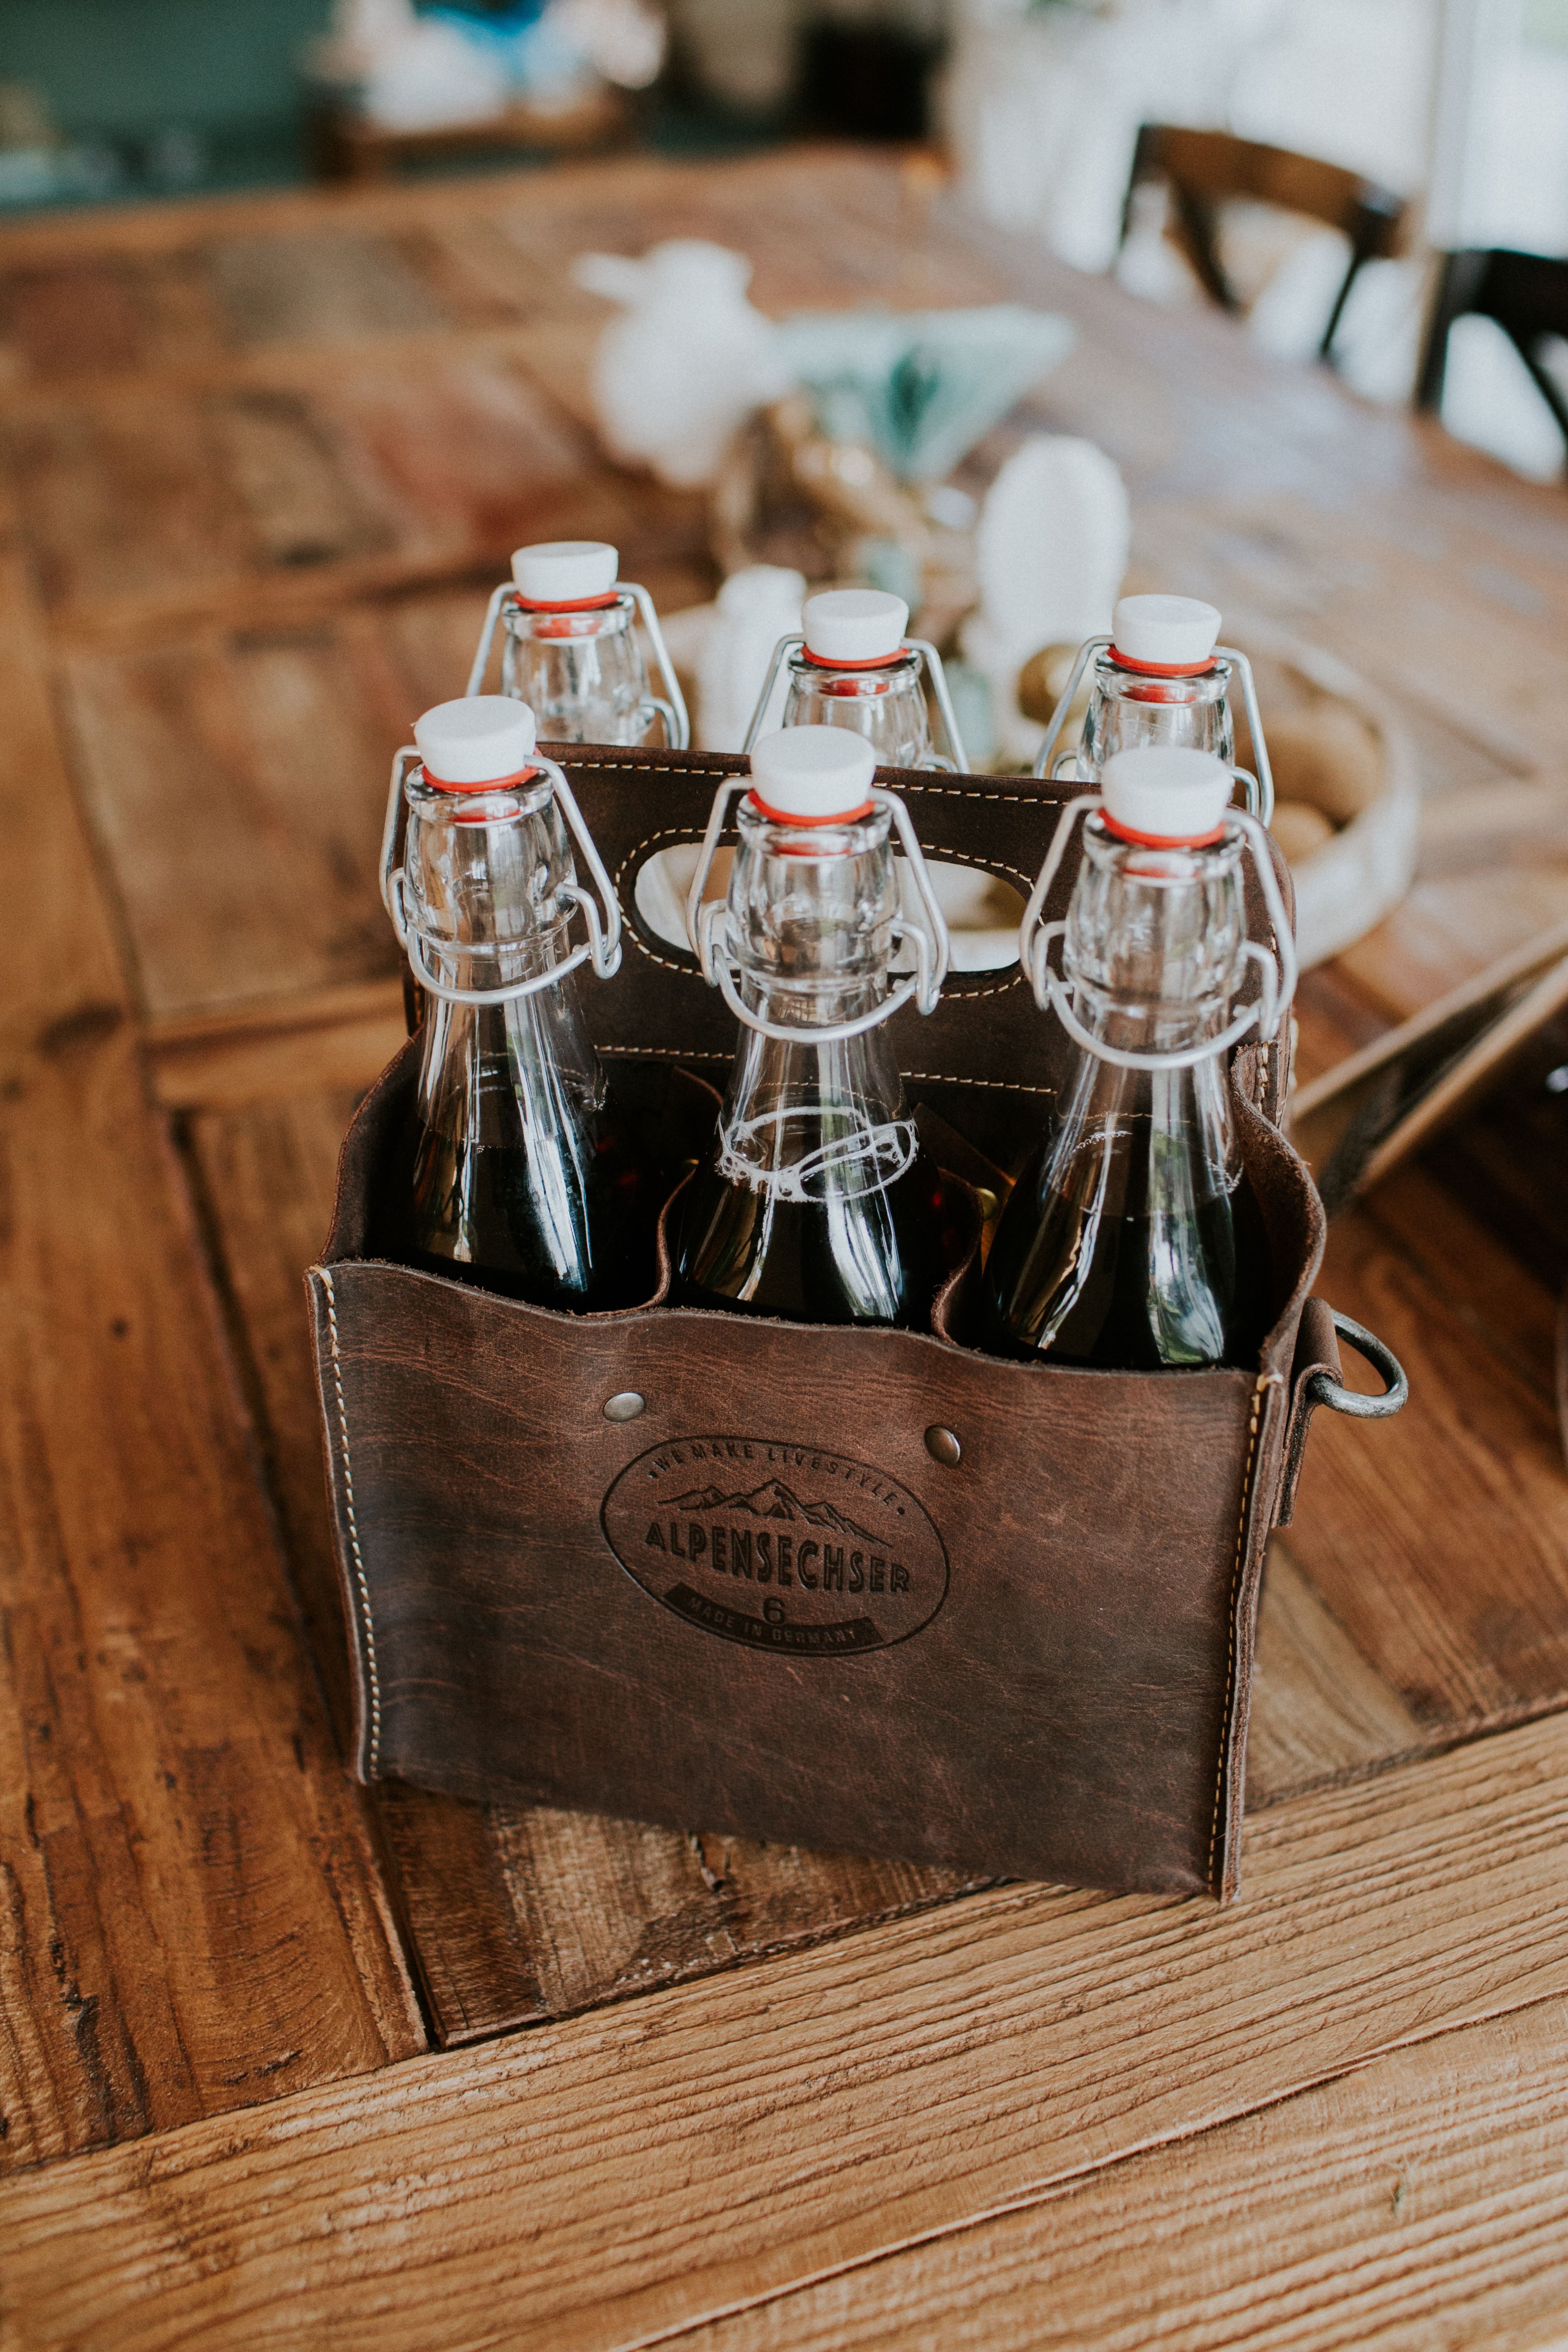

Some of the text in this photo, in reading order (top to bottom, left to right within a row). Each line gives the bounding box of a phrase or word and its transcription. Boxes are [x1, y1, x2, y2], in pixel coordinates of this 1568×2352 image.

[653, 1443, 897, 1506] WE MAKE LIVESTYLE
[646, 1521, 910, 1594] ALPENSECHSER
[687, 1596, 856, 1644] MADE IN GERMANY
[762, 1596, 786, 1625] 6
